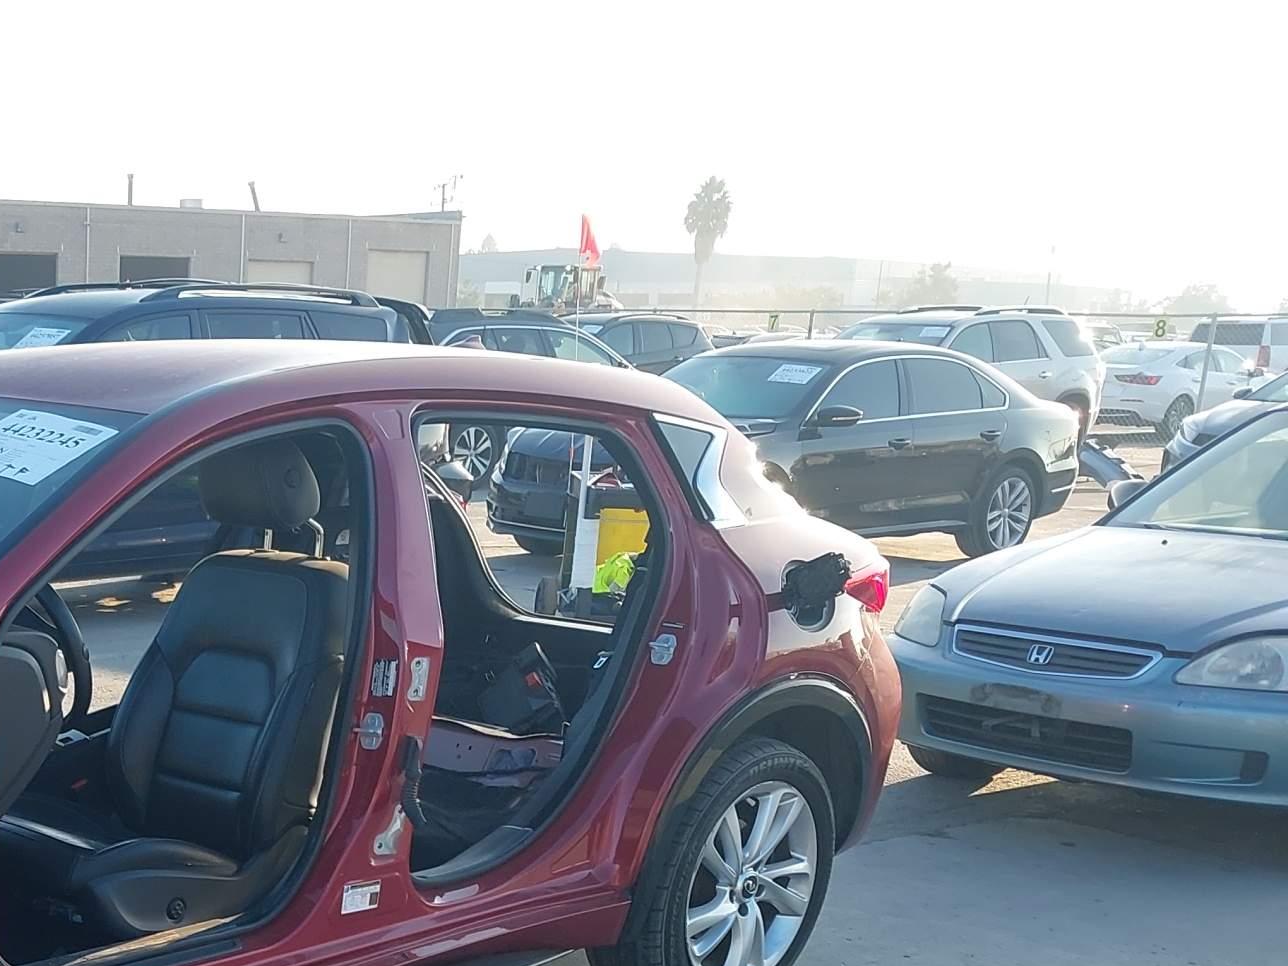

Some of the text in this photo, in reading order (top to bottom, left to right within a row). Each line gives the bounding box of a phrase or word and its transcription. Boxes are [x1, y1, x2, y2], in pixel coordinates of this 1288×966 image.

[770, 314, 779, 330] 7
[1155, 319, 1167, 338] 8
[1, 423, 87, 448] 44232245
